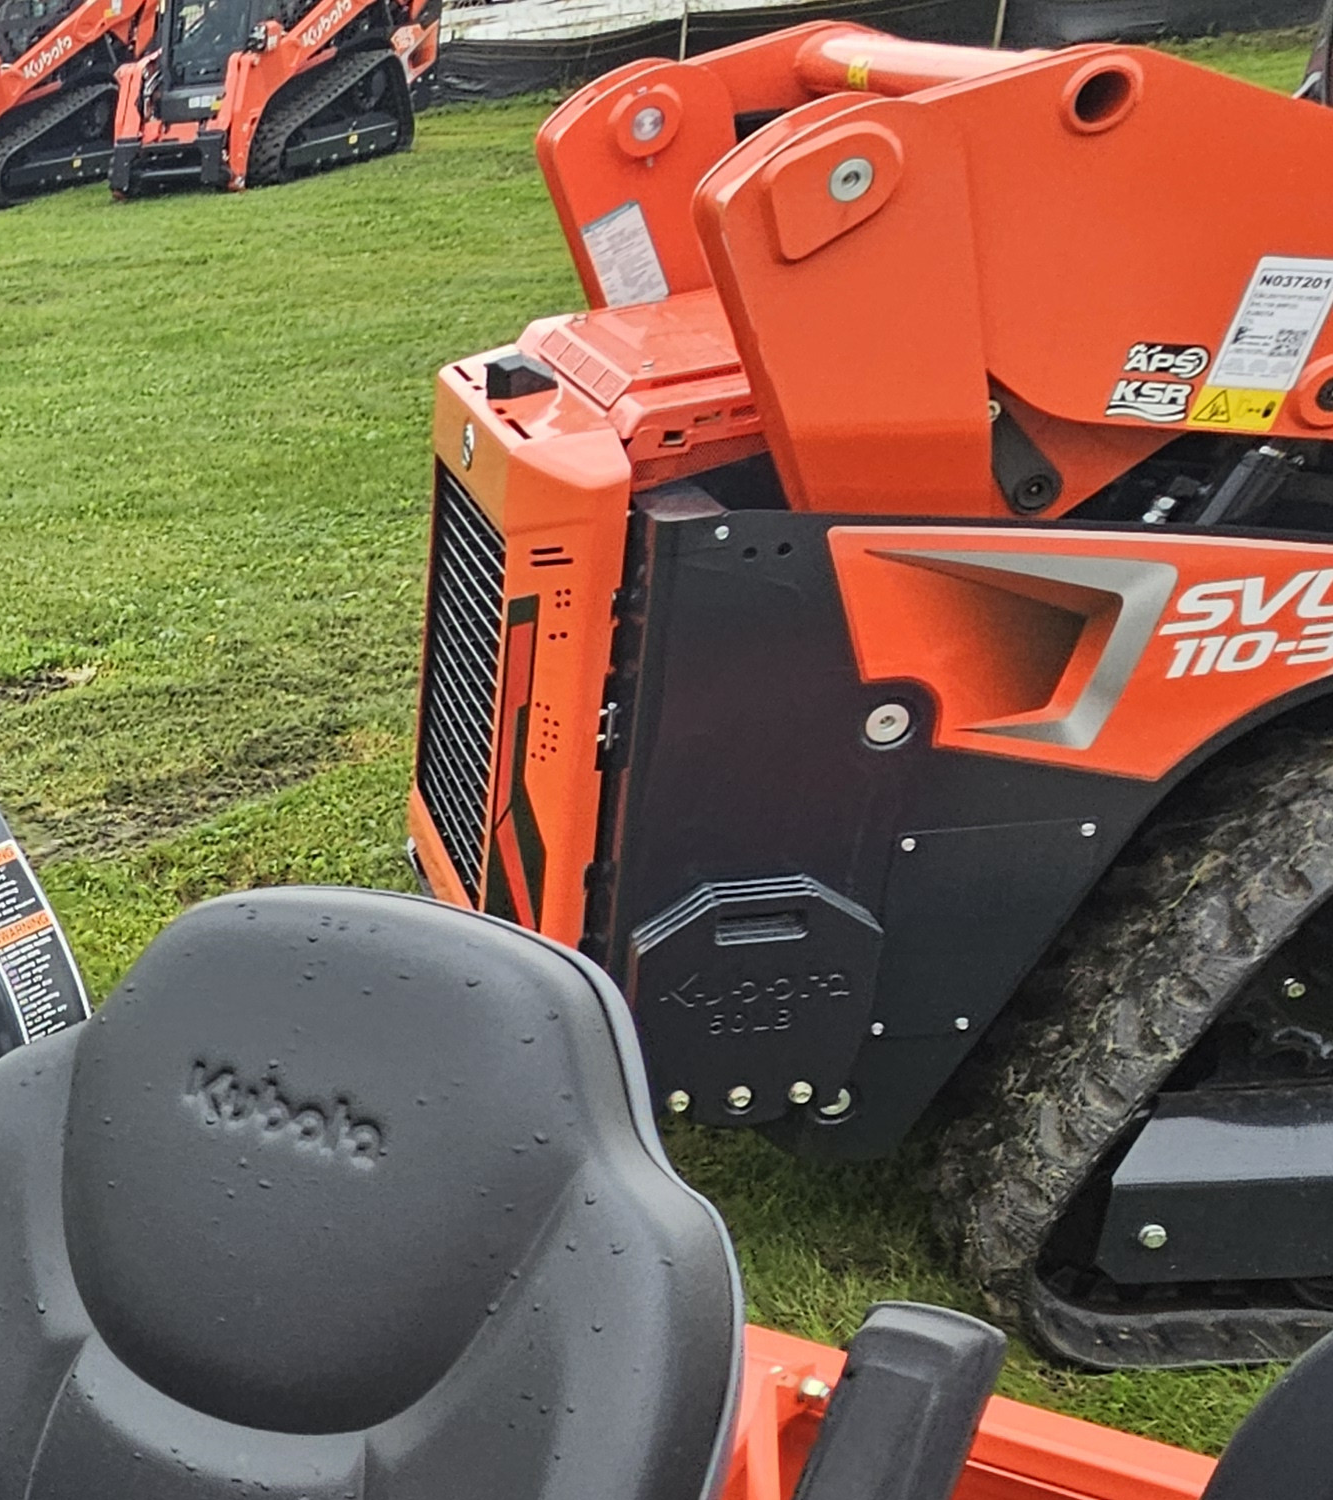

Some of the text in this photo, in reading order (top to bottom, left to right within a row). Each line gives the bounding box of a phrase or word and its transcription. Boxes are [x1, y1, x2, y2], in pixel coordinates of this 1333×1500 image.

[301, 0, 353, 47] Kubota
[23, 35, 73, 79] Kubota
[1123, 345, 1209, 379] APS
[1112, 380, 1192, 405] KSR
[0, 913, 50, 943] WARNING
[182, 1058, 386, 1168] Kubota
